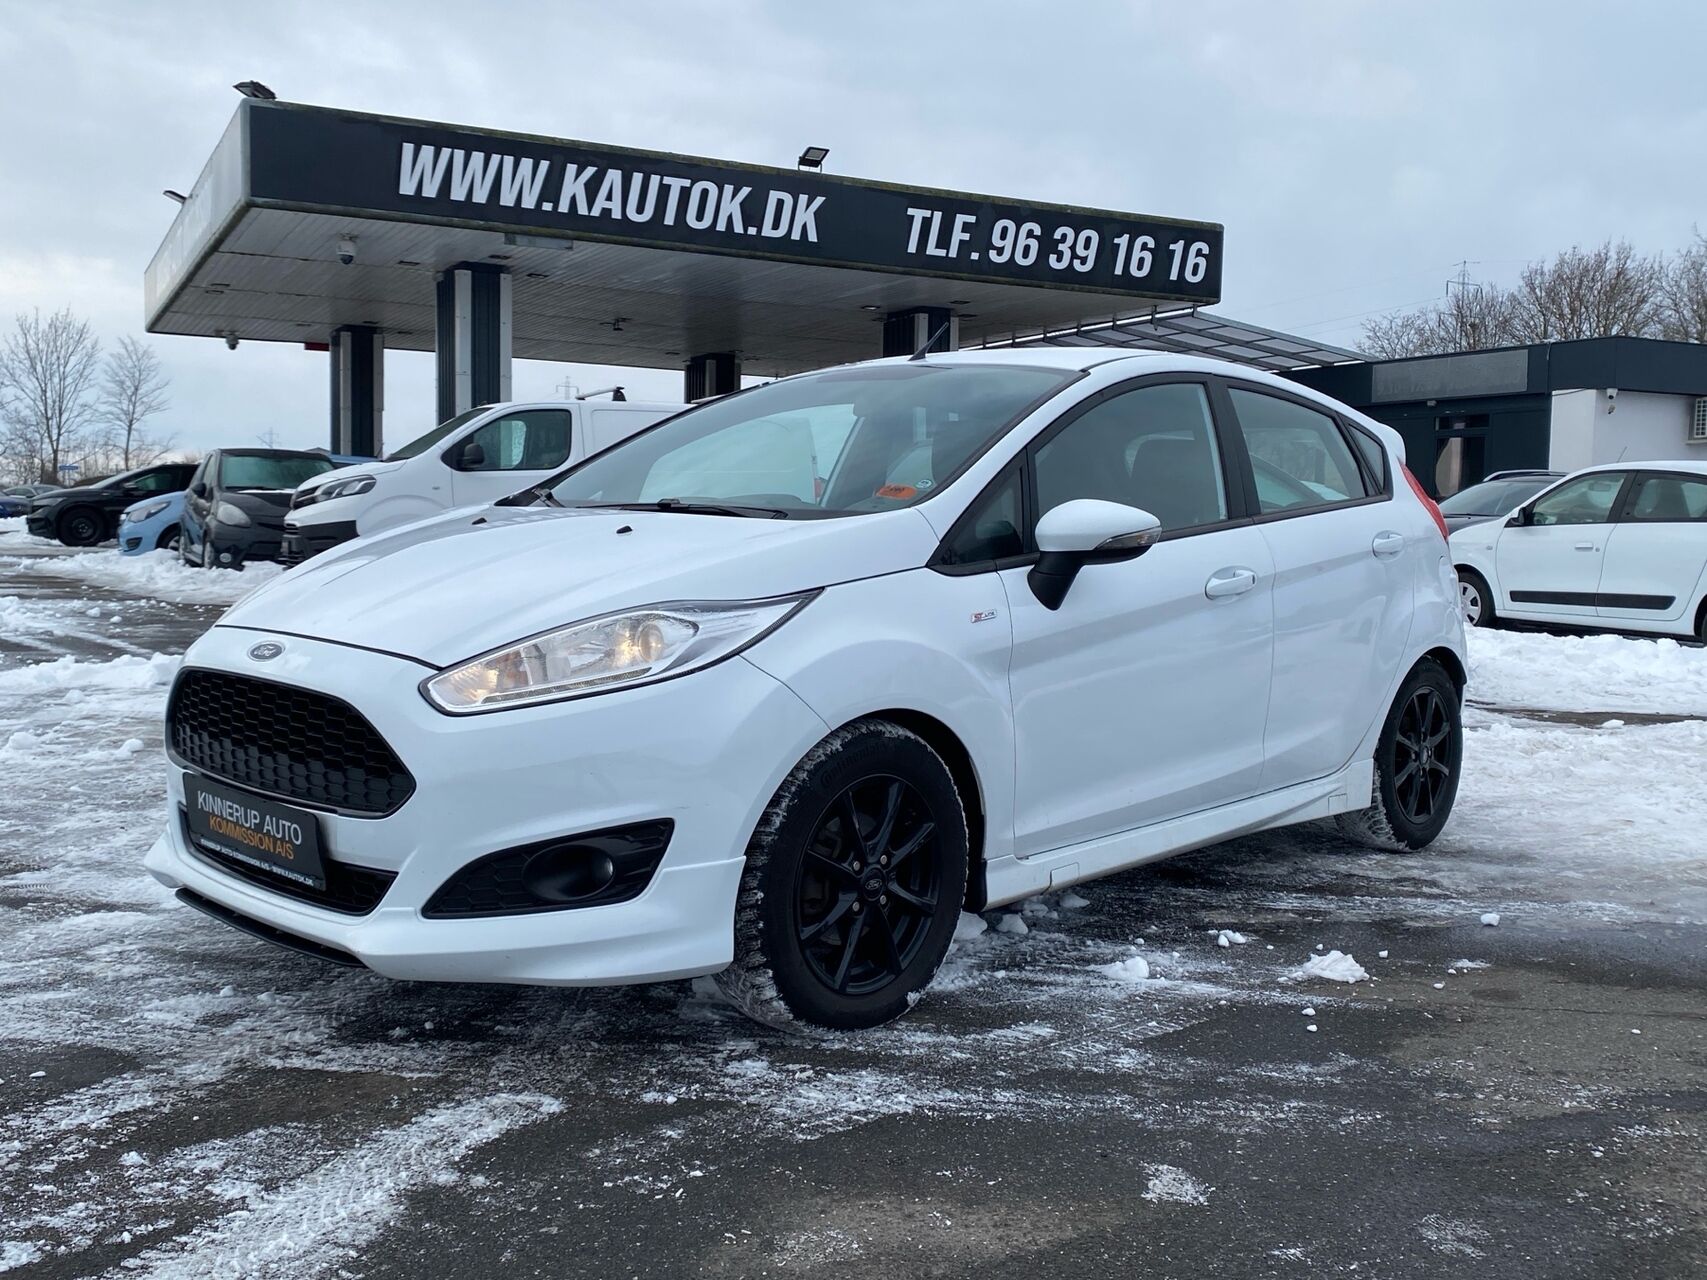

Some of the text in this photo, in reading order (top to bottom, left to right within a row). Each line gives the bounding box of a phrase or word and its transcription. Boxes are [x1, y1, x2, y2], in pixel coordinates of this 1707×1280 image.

[399, 142, 1210, 283] WWW.KAUTOK.DK TLF. 96 39 16 16
[253, 645, 277, 656] Ford
[197, 790, 302, 845] KINNERUP AUTO
[209, 815, 274, 853] KOMMISSION
[275, 841, 294, 859] A/S
